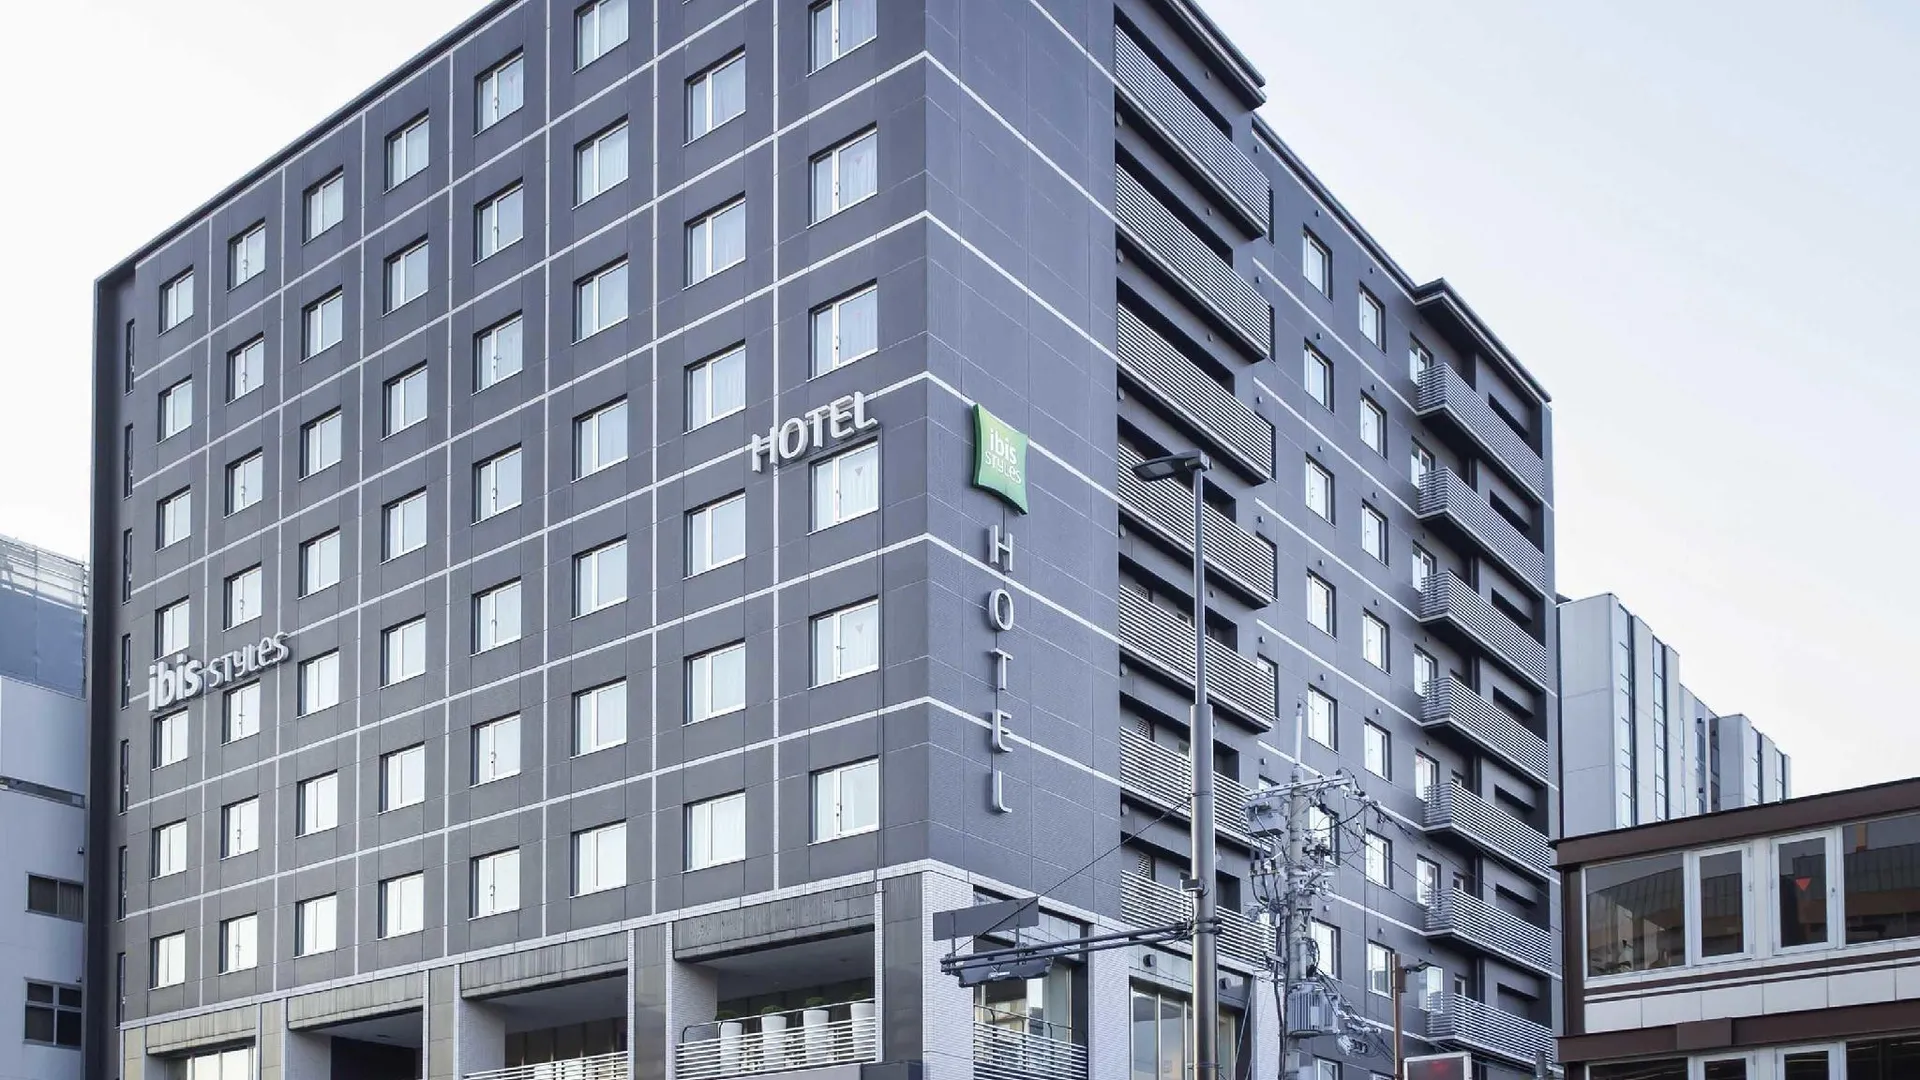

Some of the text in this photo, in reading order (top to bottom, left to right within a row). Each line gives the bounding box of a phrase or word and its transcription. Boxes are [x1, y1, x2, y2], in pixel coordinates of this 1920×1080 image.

[751, 391, 878, 473] HOTEL
[989, 428, 1017, 465] ibis
[149, 653, 203, 711] ibis
[989, 524, 1014, 813] HOTEL
